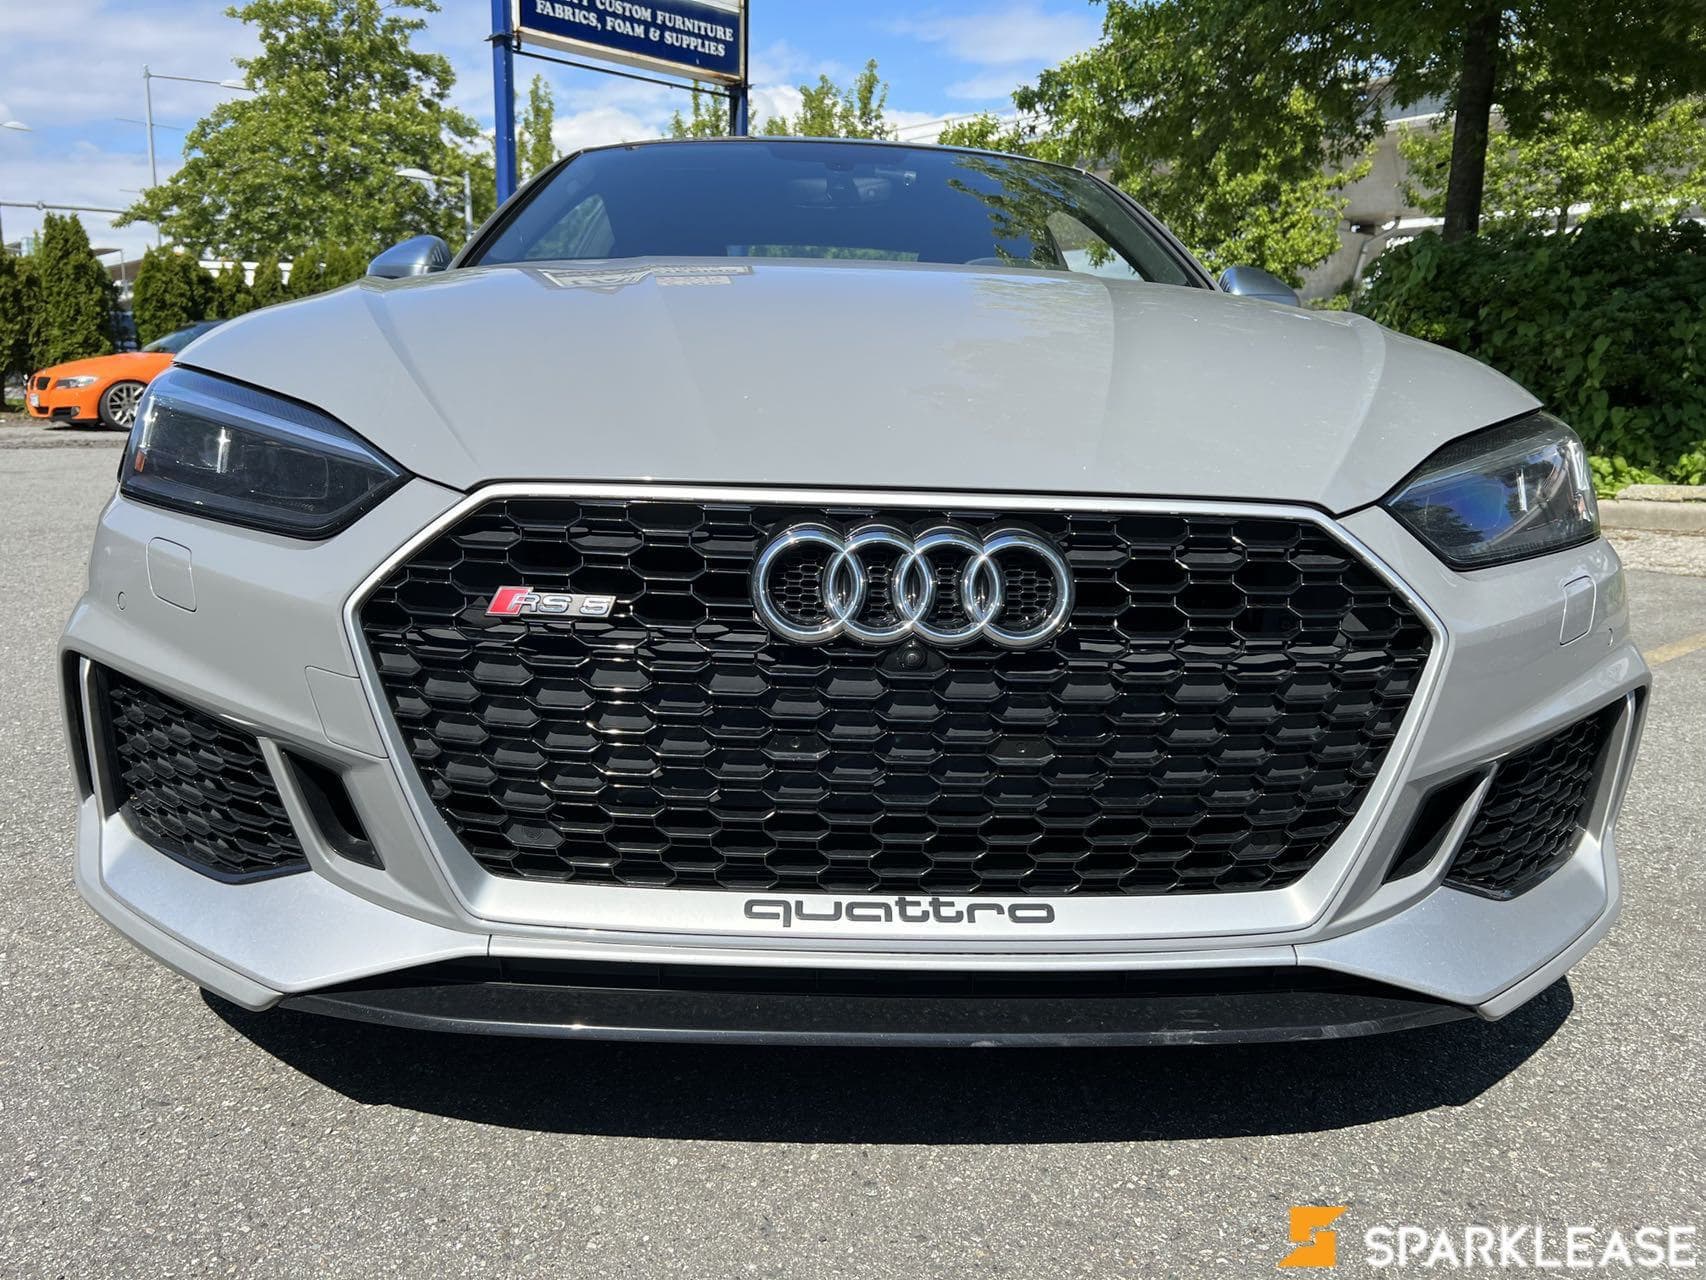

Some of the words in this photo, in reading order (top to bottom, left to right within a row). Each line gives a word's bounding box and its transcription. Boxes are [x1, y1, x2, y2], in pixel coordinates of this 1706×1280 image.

[536, 0, 601, 31] FABRICS,
[606, 16, 645, 39] FOAM
[649, 27, 661, 42] &
[664, 31, 726, 57] SUPPLIES
[596, 0, 652, 22] CUSTOM
[656, 10, 734, 42] FURNITURE
[744, 896, 1055, 927] quattro
